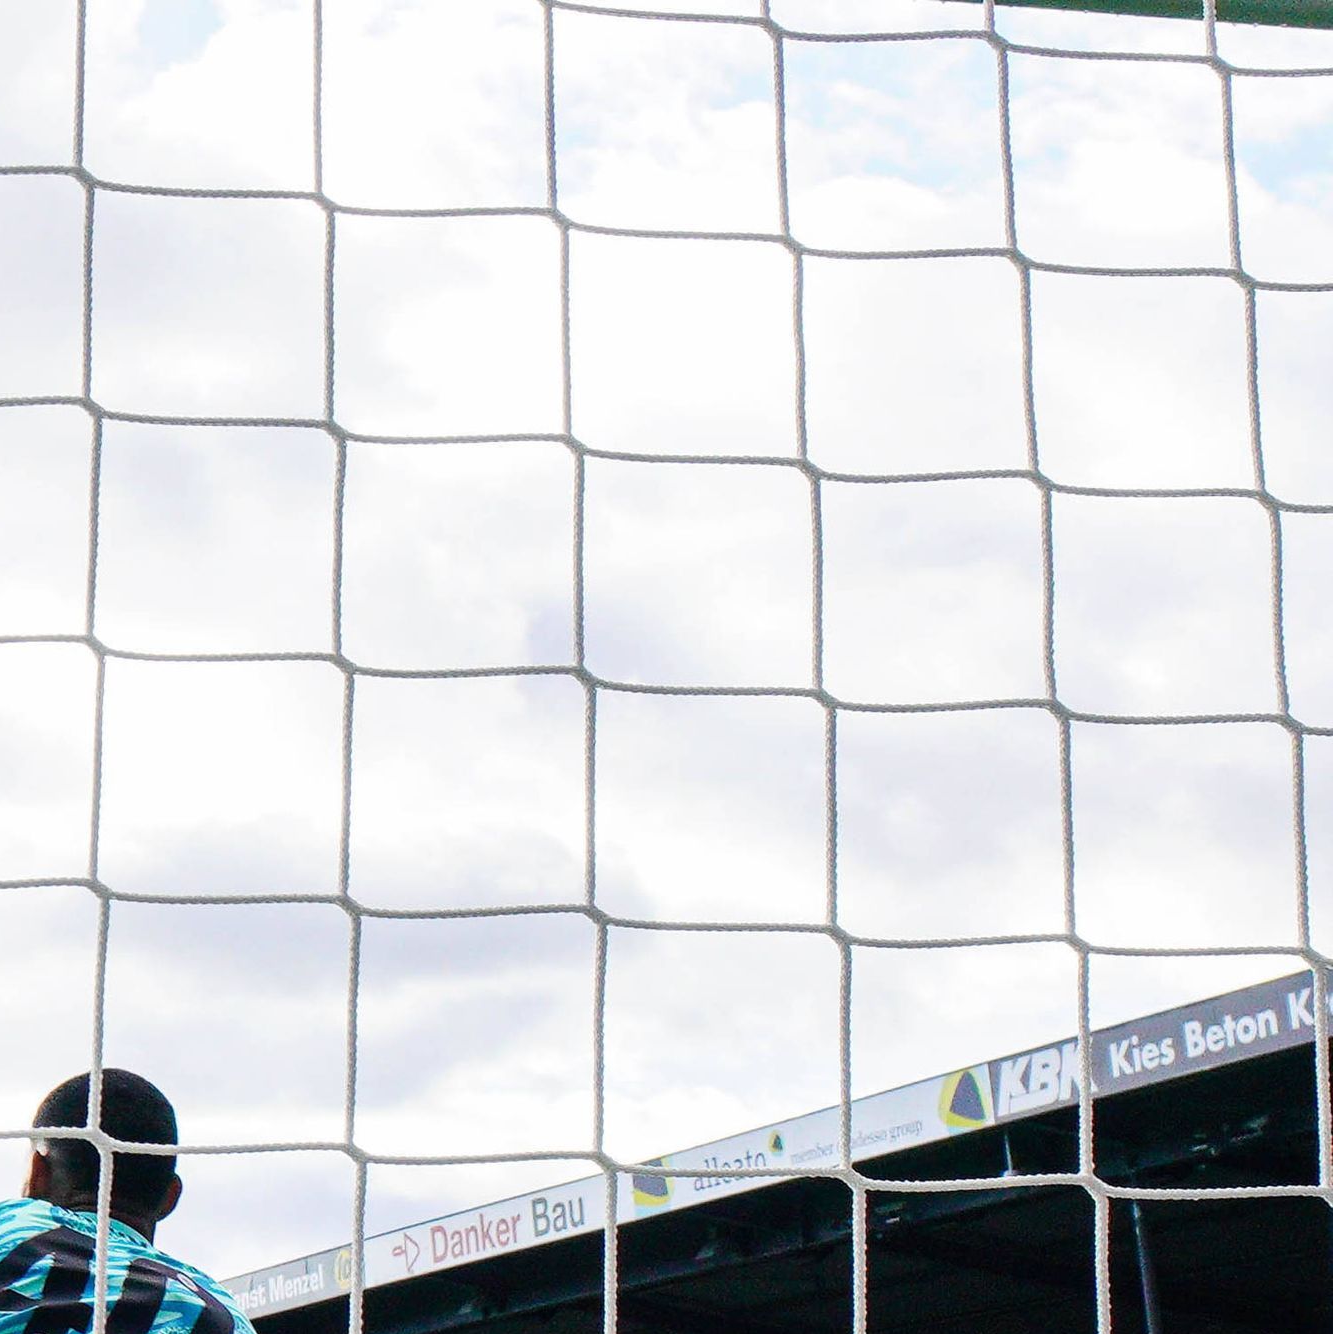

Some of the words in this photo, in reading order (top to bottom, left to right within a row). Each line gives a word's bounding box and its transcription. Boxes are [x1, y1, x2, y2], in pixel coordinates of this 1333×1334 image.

[997, 1038, 1097, 1117] KBK
[1109, 1034, 1176, 1079] Kies
[1183, 1007, 1280, 1058] Beton
[429, 1211, 521, 1263] Danker
[531, 1194, 585, 1239] Bau
[268, 1263, 324, 1302] Menzel
